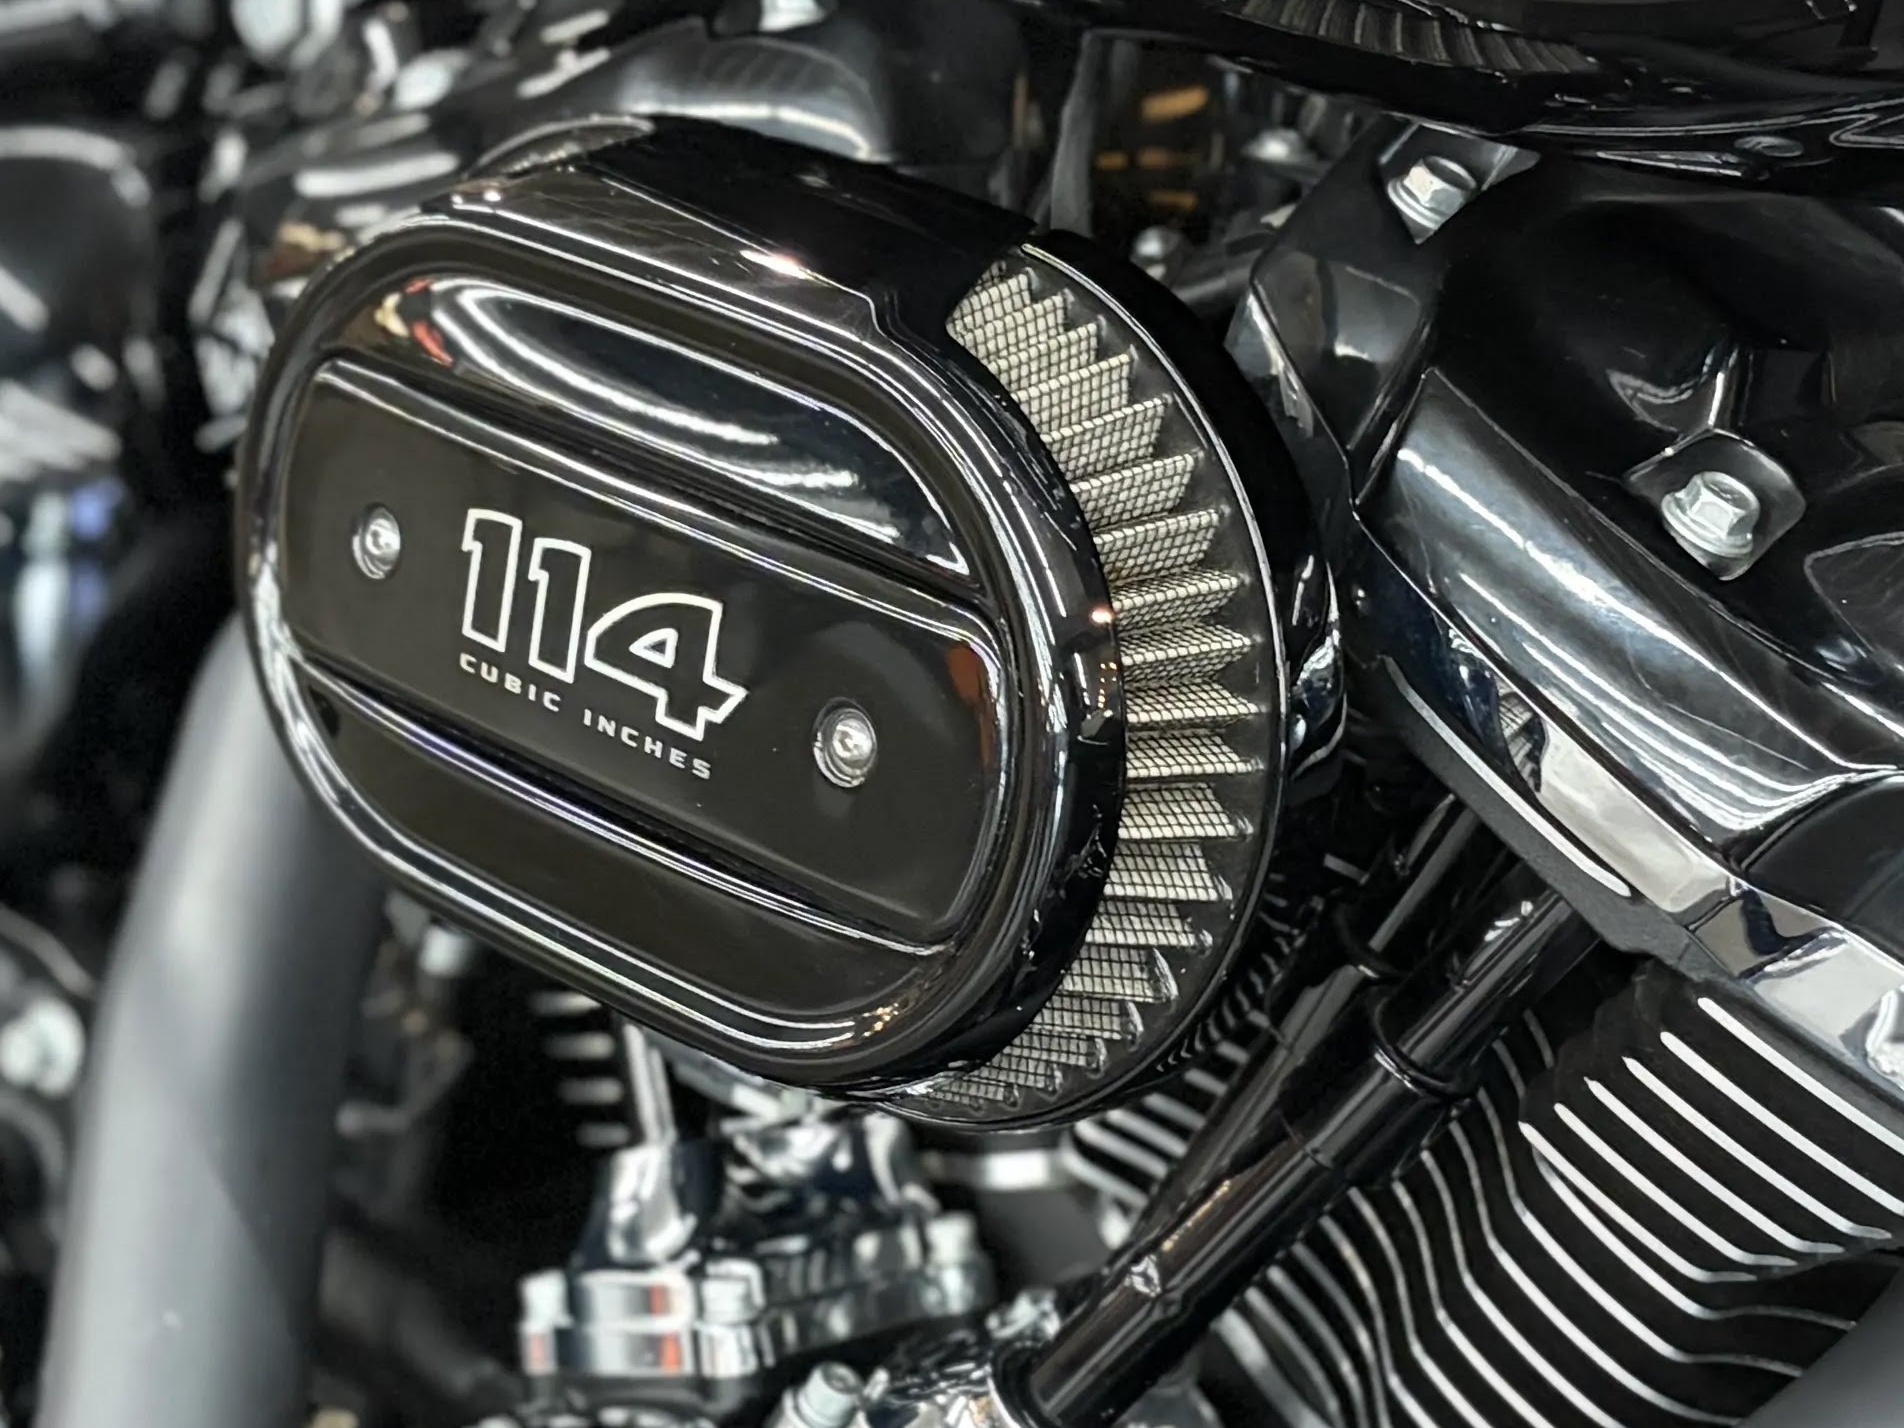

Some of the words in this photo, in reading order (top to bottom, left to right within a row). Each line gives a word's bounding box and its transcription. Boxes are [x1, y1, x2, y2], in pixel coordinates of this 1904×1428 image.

[460, 508, 748, 741] 114
[459, 652, 561, 715] CUBIC
[583, 707, 713, 781] INCHES
